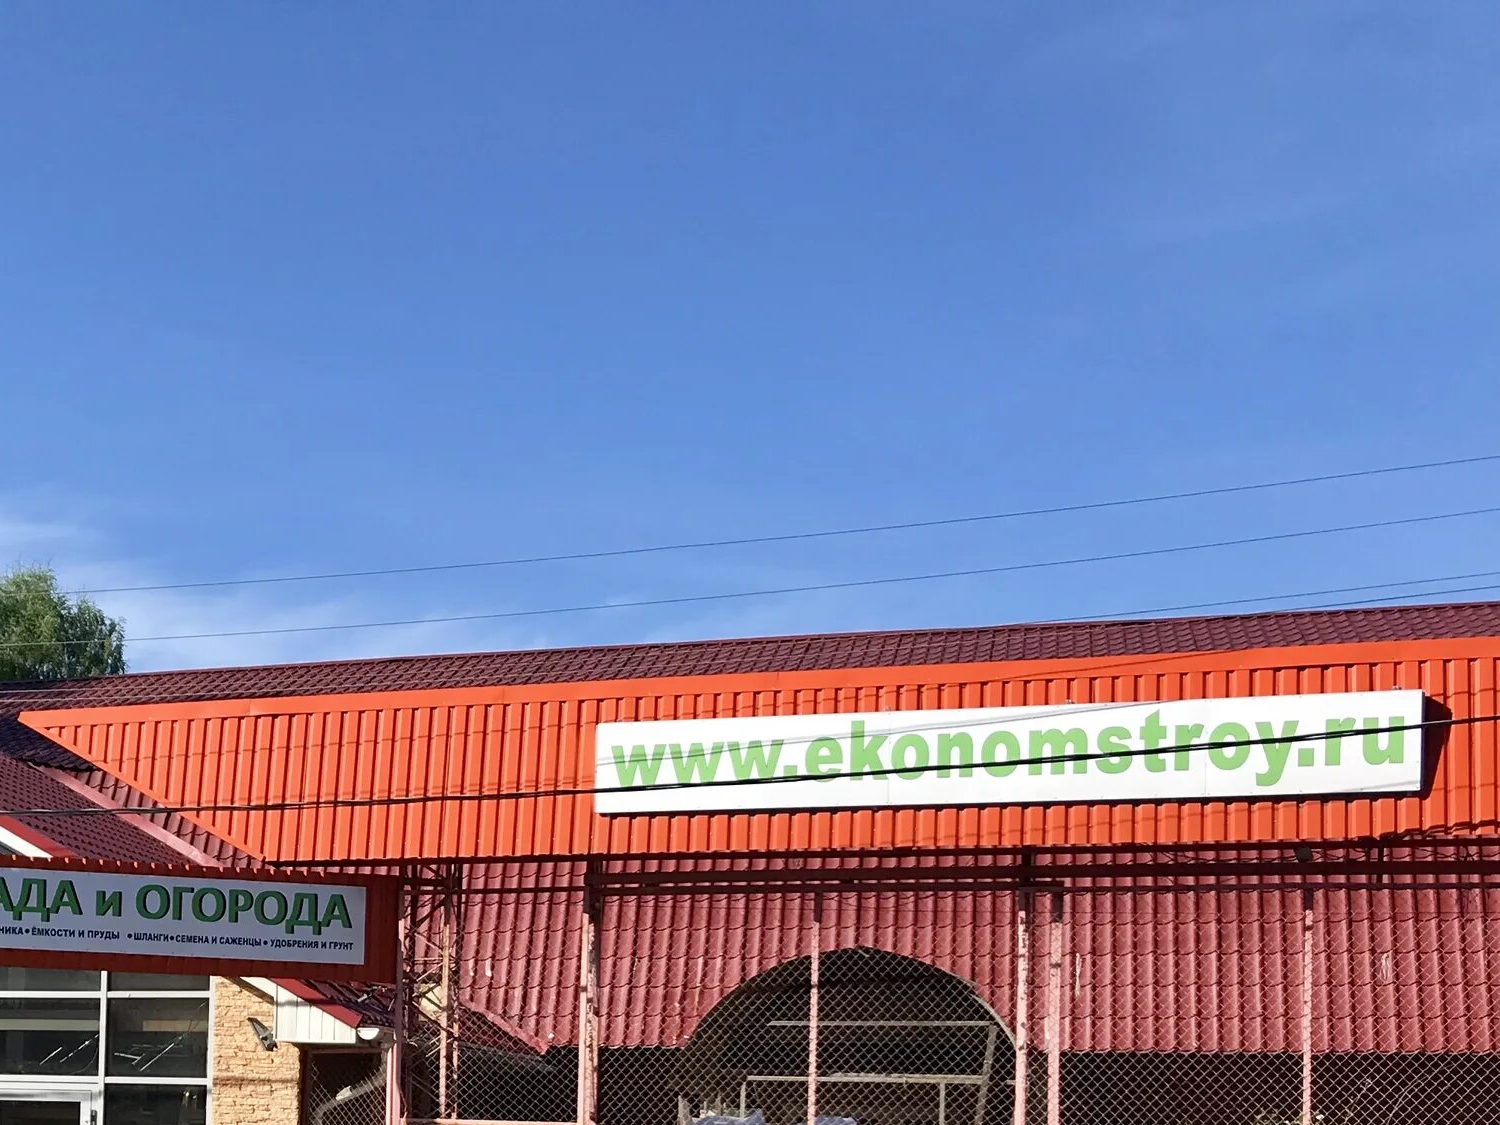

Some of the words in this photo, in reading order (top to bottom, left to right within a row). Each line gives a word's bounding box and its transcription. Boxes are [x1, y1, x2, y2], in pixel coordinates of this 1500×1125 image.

[611, 709, 1405, 787] www.ekonomstroy.ru
[96, 890, 122, 917] и
[135, 884, 353, 935] ОГОРОДА
[78, 929, 85, 938] И
[87, 929, 120, 940] ПРУДЫ
[133, 931, 169, 943] ШЛАНГИ
[175, 933, 210, 944] СЕМЕНА
[211, 935, 218, 945] И
[219, 936, 262, 947] САЖЕНЦЫ
[270, 938, 319, 949] УДОБРЕНИЯ
[321, 940, 328, 949] И
[329, 941, 354, 951] ГРУНТ
